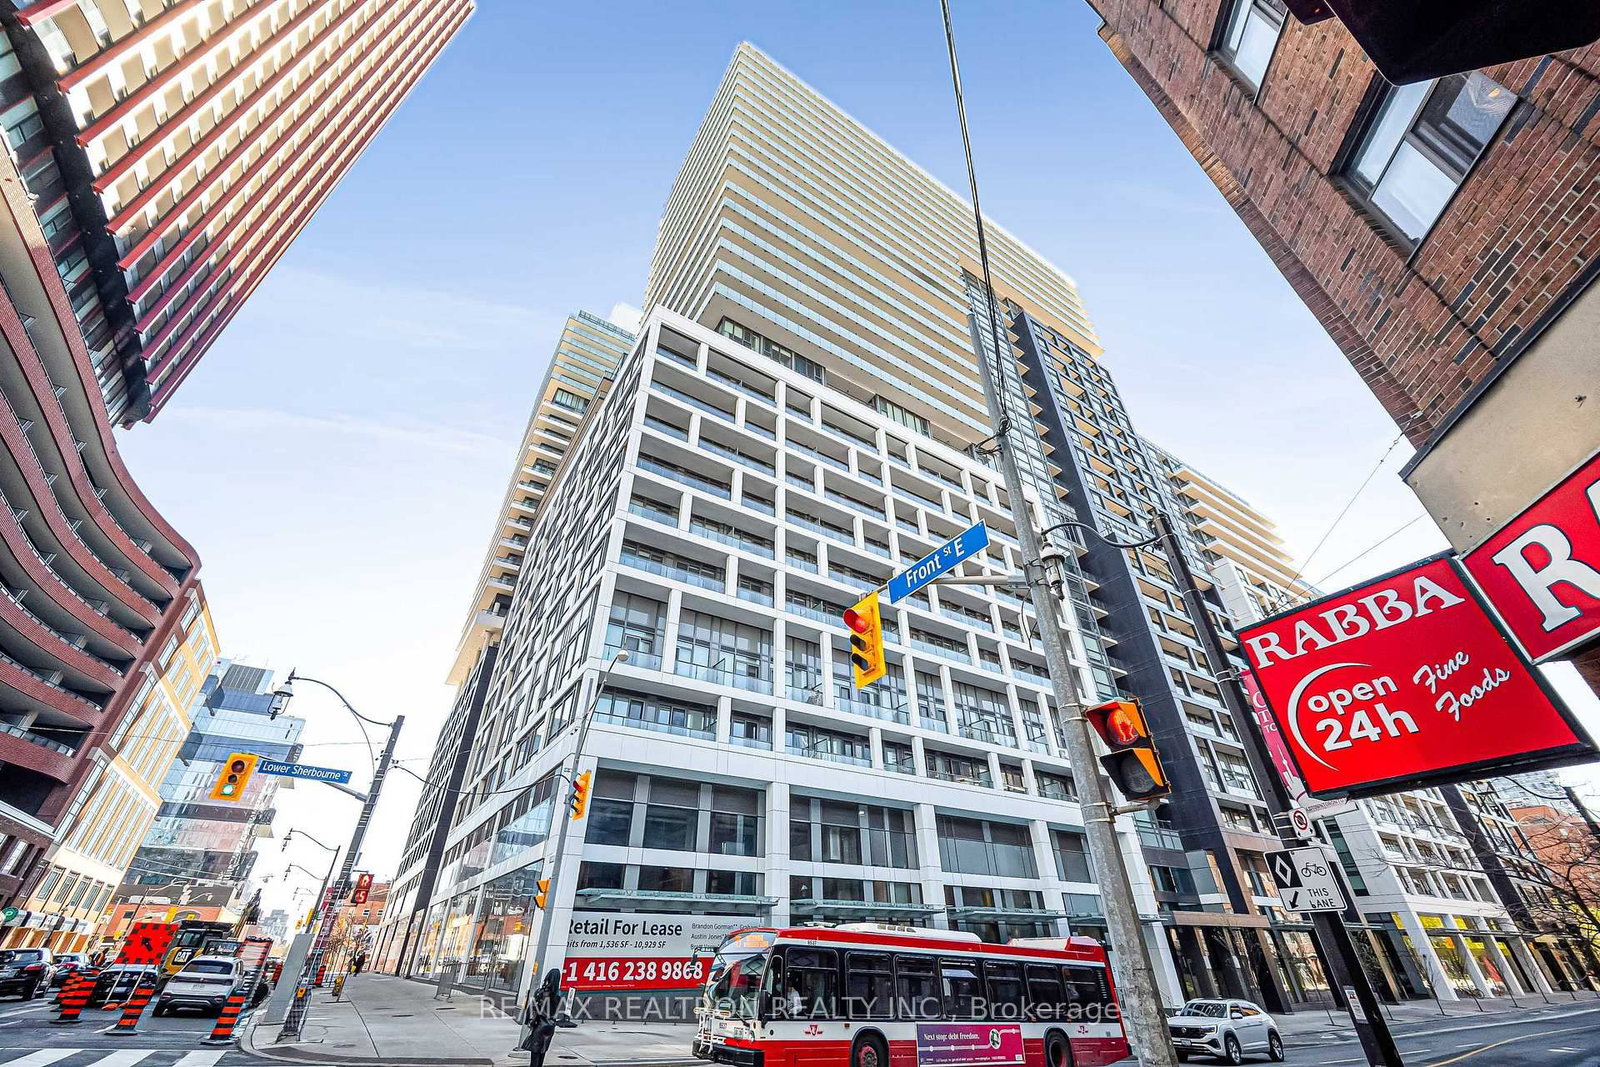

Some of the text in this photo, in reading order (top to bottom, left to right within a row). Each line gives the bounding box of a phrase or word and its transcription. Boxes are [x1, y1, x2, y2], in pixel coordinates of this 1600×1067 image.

[905, 537, 965, 588] Front St E
[1491, 479, 1600, 633] R
[1246, 576, 1465, 669] RABBA
[1413, 650, 1469, 694] Fine
[1307, 675, 1399, 715] open
[1436, 667, 1510, 721] Foods
[1315, 703, 1419, 752] 24h
[262, 762, 291, 774] Lower
[292, 765, 341, 780] Sherbourne
[1307, 888, 1329, 897] THIS
[567, 940, 579, 948] nits
[580, 940, 598, 948] from
[599, 941, 619, 949] 1,536
[634, 941, 657, 950] 10,929
[658, 941, 666, 949] SF
[613, 920, 639, 935] For
[642, 921, 682, 936] Lease
[174, 951, 192, 962] CAT
[583, 962, 620, 981] 416
[623, 962, 657, 980] 238
[661, 962, 703, 980] 9868
